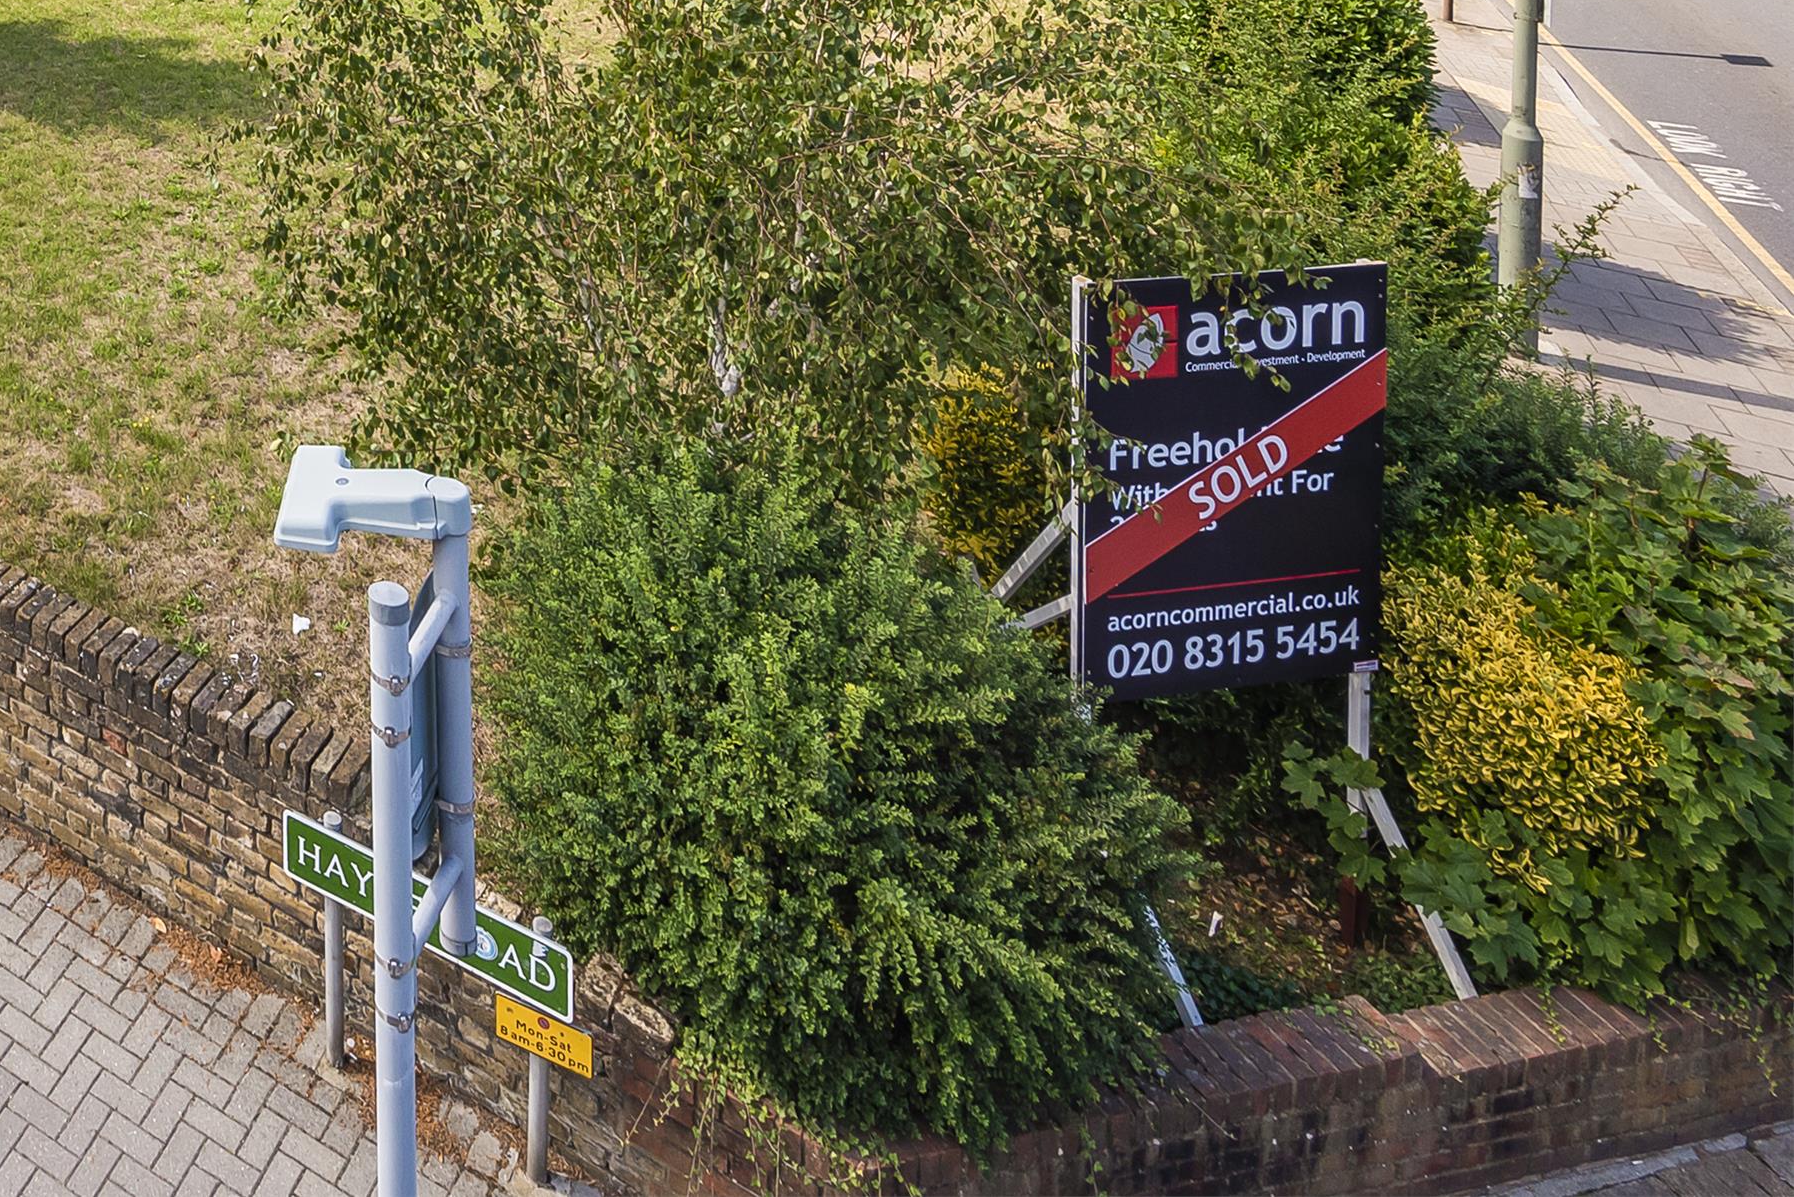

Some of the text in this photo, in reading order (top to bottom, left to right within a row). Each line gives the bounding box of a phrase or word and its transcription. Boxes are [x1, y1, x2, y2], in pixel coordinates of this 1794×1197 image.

[1646, 119, 1728, 159] LOOK
[1690, 163, 1784, 212] RIGHT
[1185, 300, 1366, 357] acorn
[1185, 360, 1240, 373] Commercia
[1307, 349, 1366, 364] Development
[1188, 434, 1289, 521] SOLD
[1291, 469, 1335, 494] For
[1107, 585, 1360, 633] acorncommercial.co.uk
[1107, 617, 1360, 680] 020 8315 5454
[516, 1019, 572, 1053] Mon-Sat
[568, 1057, 589, 1073] pm
